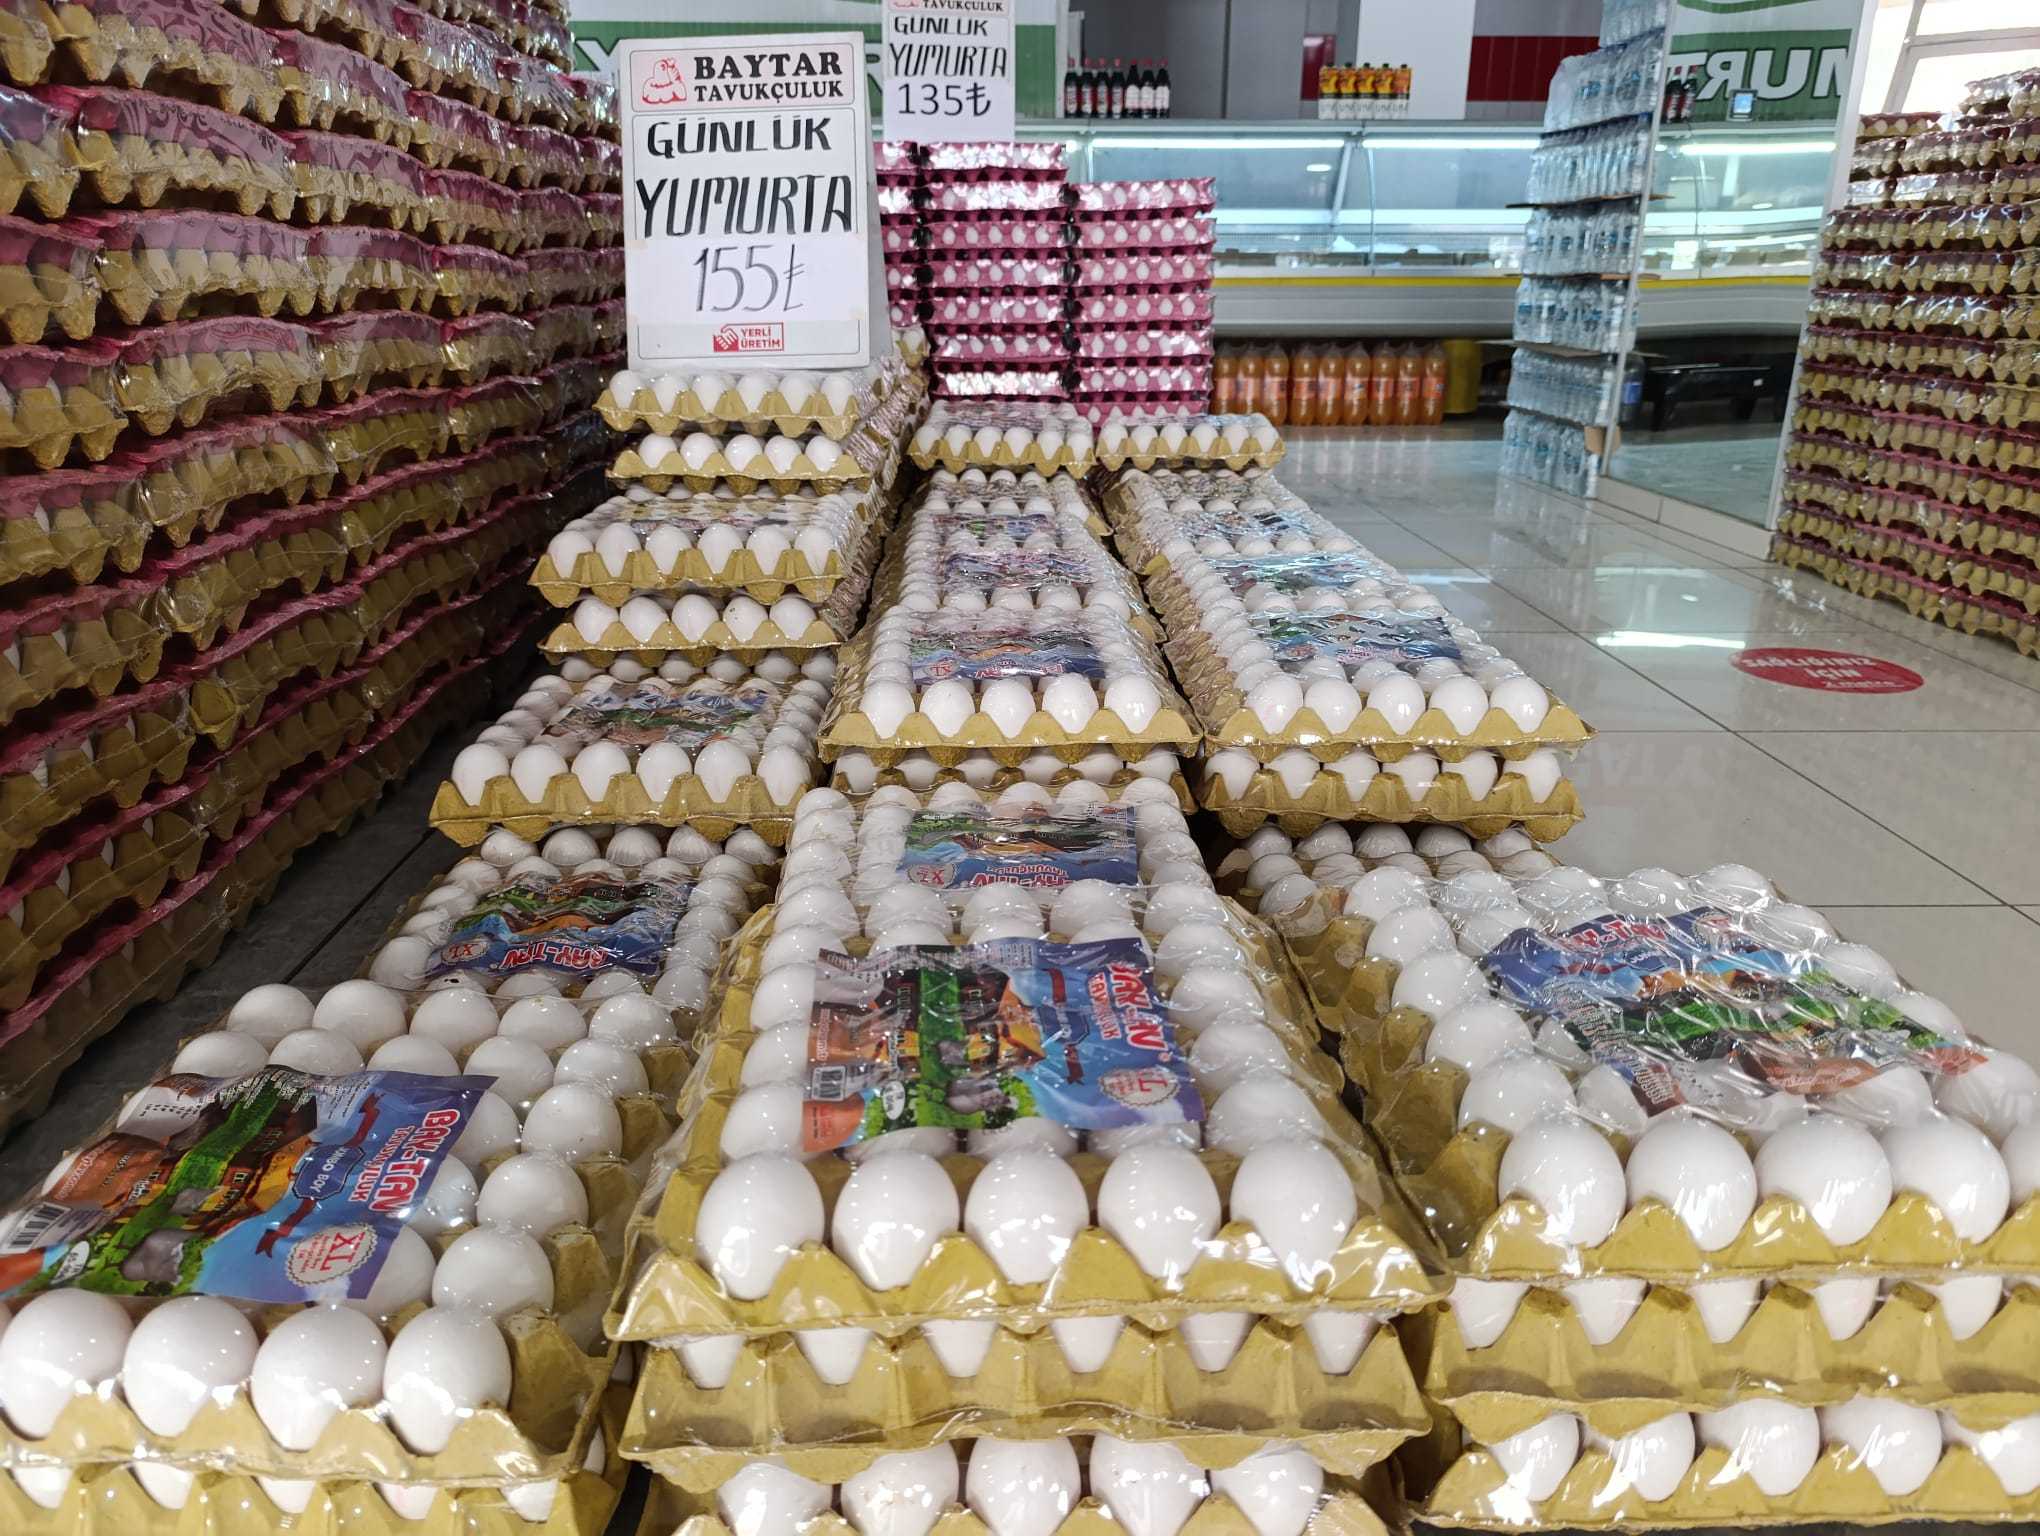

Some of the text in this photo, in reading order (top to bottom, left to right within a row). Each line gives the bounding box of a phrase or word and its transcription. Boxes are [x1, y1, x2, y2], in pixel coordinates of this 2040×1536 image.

[693, 51, 843, 80] BAYTAR
[889, 42, 1007, 77] YUMURTA
[694, 80, 844, 103] TAVUKÇULUK
[647, 115, 832, 159] GÜNLÜK
[636, 174, 852, 238] YUMURTA
[369, 1108, 461, 1212] BAY-TAN
[320, 1231, 366, 1271] XL
